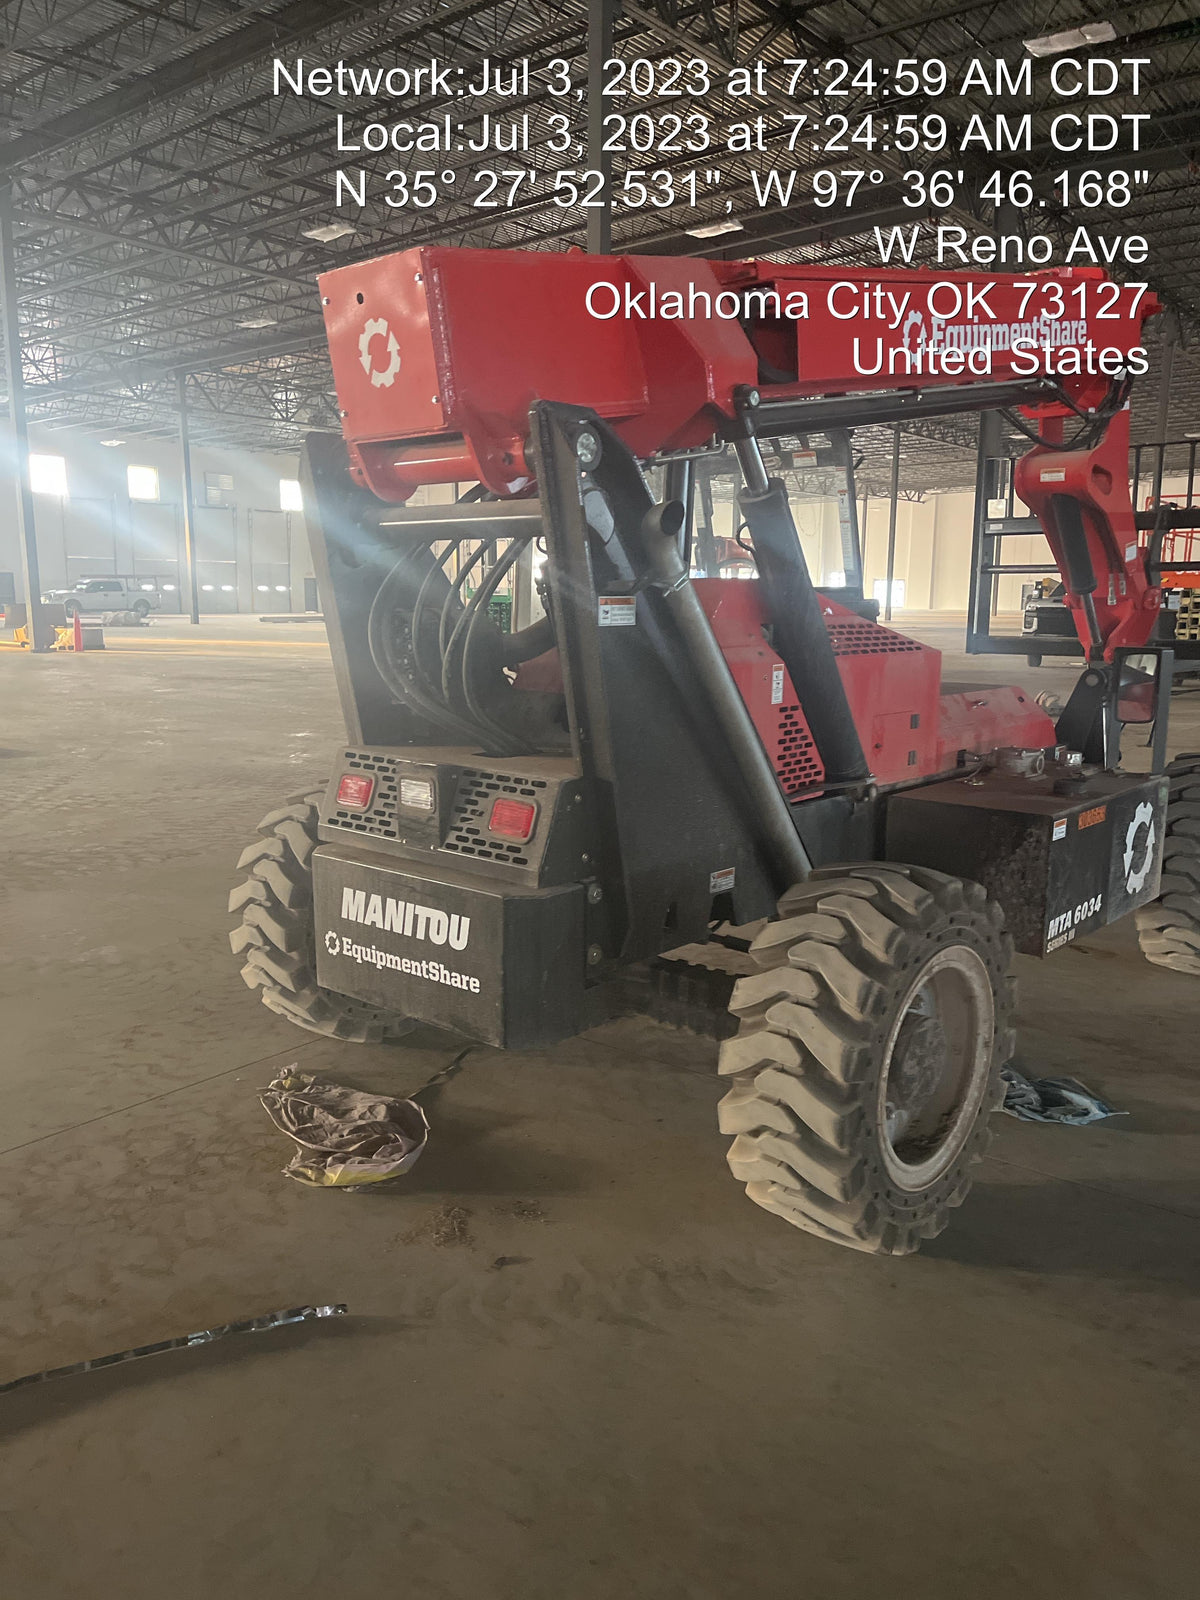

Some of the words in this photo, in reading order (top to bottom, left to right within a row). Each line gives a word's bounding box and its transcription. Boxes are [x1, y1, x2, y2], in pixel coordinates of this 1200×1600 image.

[341, 886, 471, 951] MANITOU
[1047, 909, 1072, 940] MTA
[1073, 893, 1102, 925] 6034
[342, 936, 481, 994] EquipmentShare
